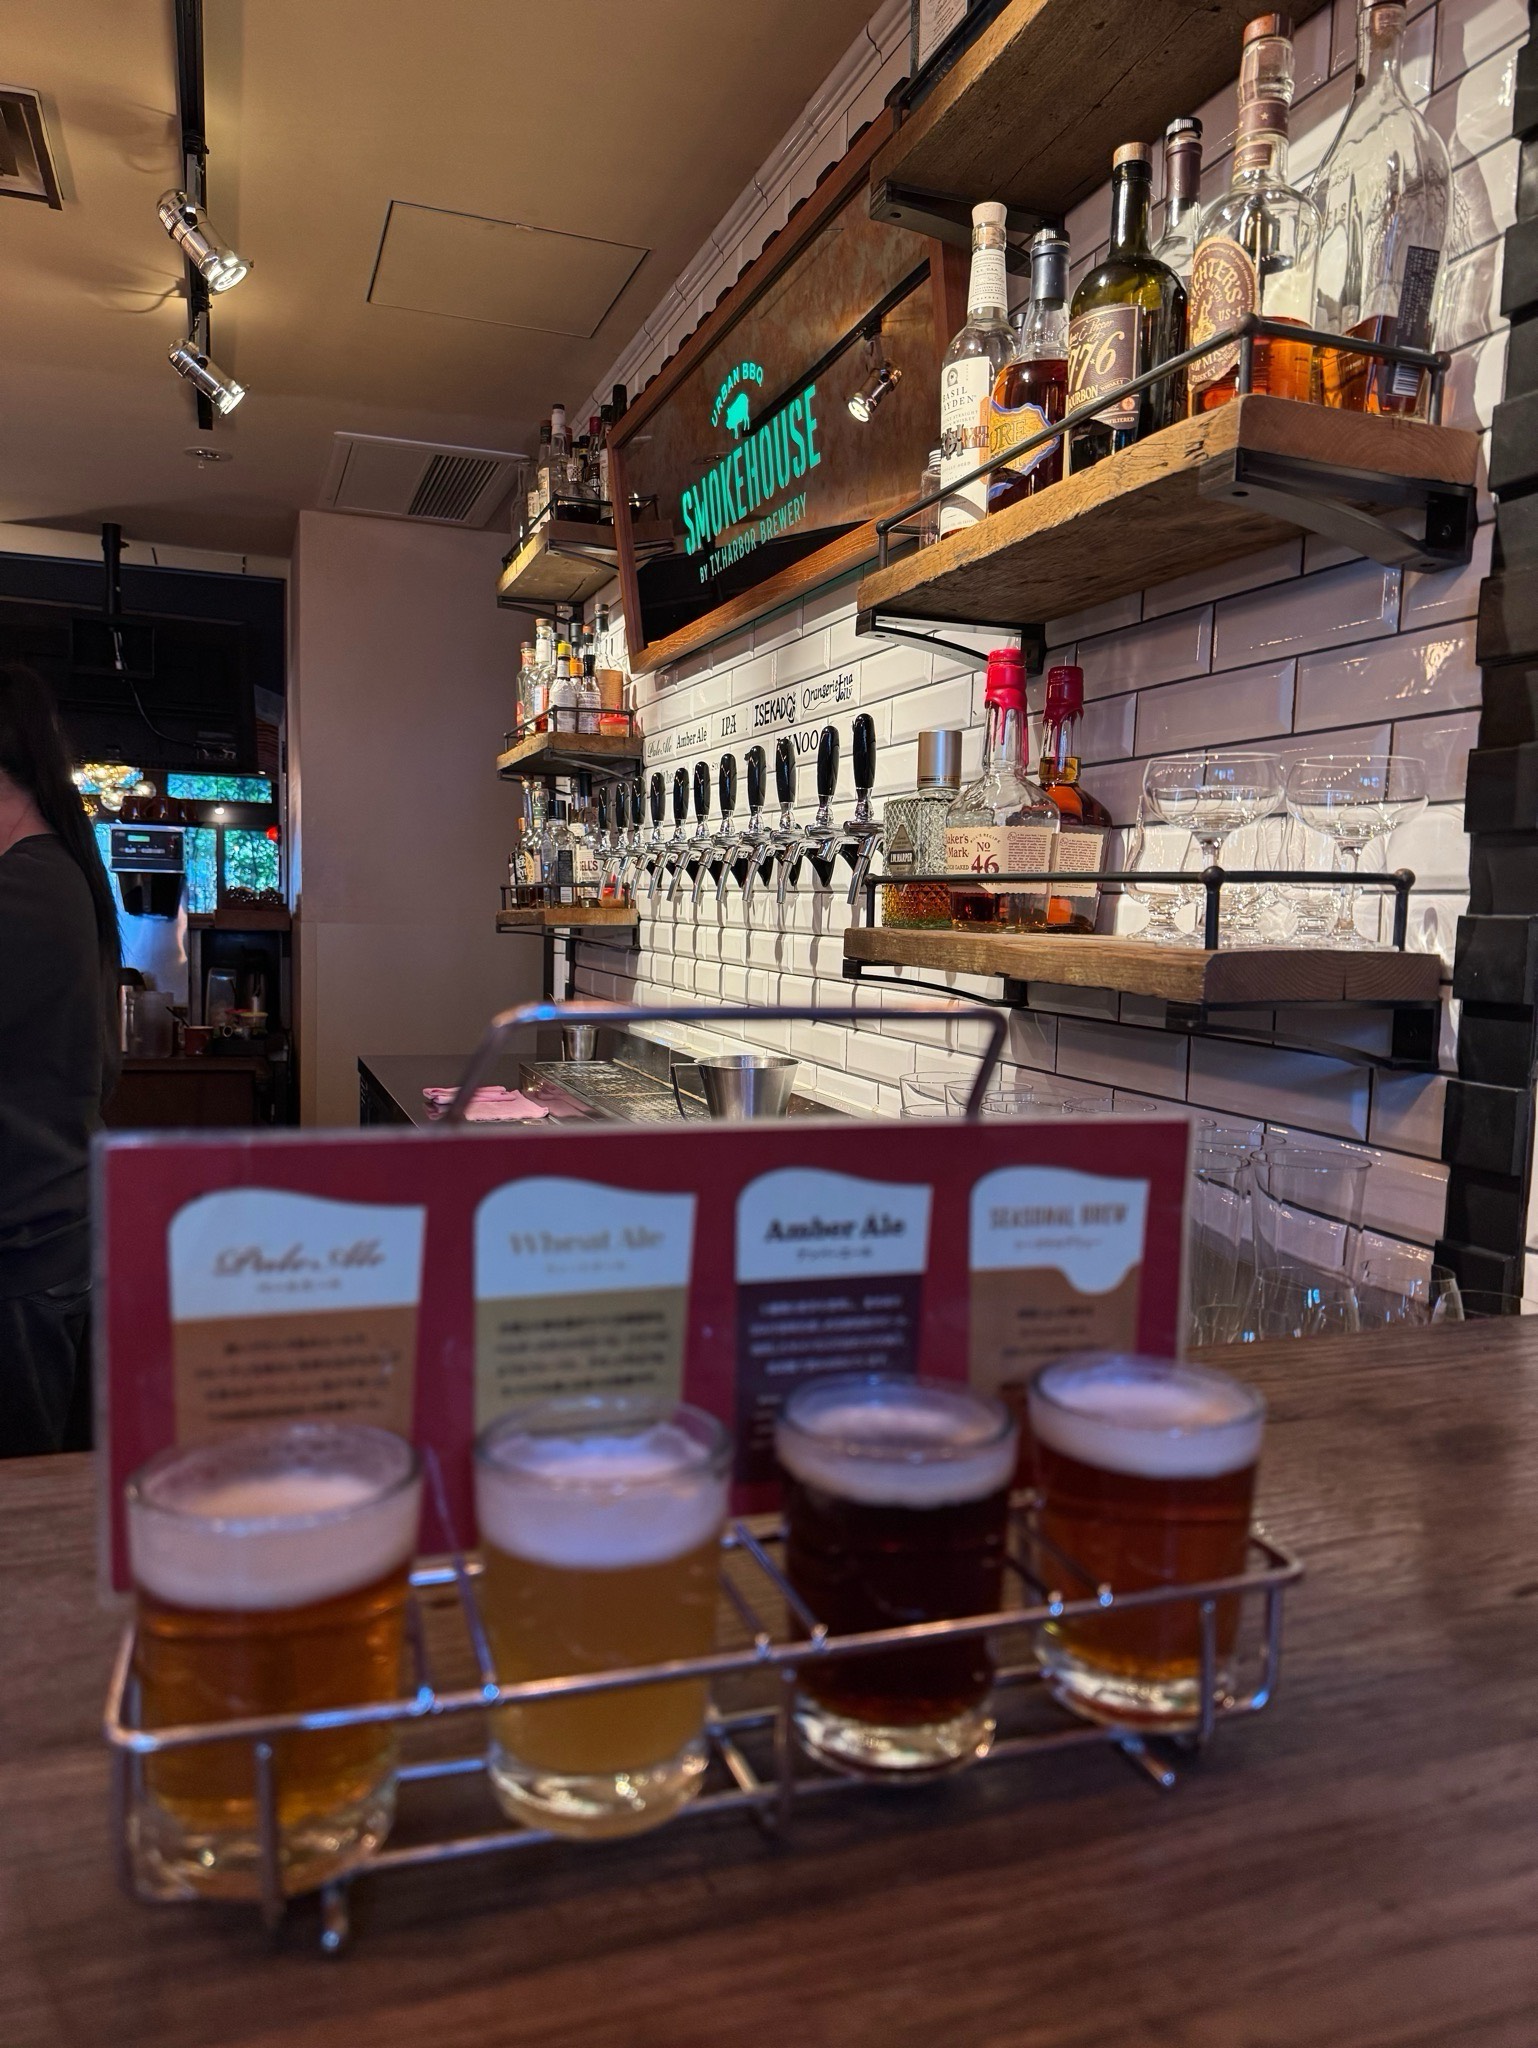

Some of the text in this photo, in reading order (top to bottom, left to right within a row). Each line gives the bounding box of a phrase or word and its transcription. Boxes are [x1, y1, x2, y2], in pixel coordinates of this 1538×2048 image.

[1191, 257, 1243, 304] CHTER'S
[1068, 331, 1126, 393] 776
[710, 362, 763, 428] URBAN BBQ
[943, 395, 975, 411] AYDEN
[1104, 416, 1135, 424] NFILTERED
[682, 383, 821, 556] SMOKEHOUSE
[699, 563, 708, 584] BY
[760, 491, 807, 544] BREWERY
[676, 726, 707, 749] Amber Ale
[720, 712, 737, 738] IPA
[945, 833, 969, 844] aker's
[970, 854, 1000, 874] 46
[764, 1211, 906, 1244] Amber Ale
[990, 1202, 1127, 1229] SEASONAL BREW
[213, 1235, 386, 1277] Pale Ale
[509, 1225, 666, 1256] Wheat Ale
